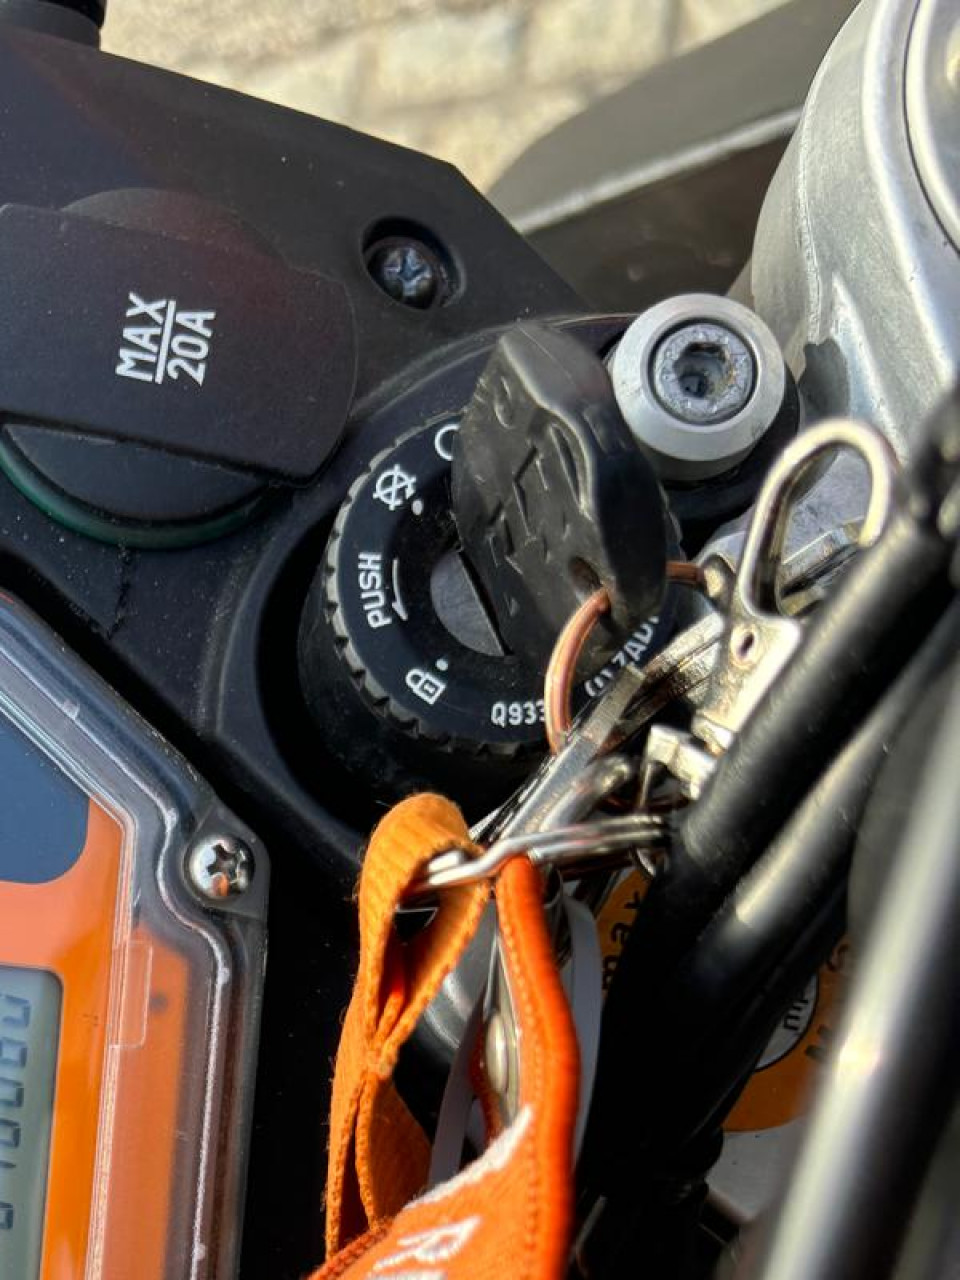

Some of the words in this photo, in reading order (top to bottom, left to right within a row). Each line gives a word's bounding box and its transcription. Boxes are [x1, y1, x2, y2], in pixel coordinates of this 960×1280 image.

[115, 291, 167, 382] MAX
[167, 311, 216, 387] 20A
[358, 552, 392, 628] PUSH
